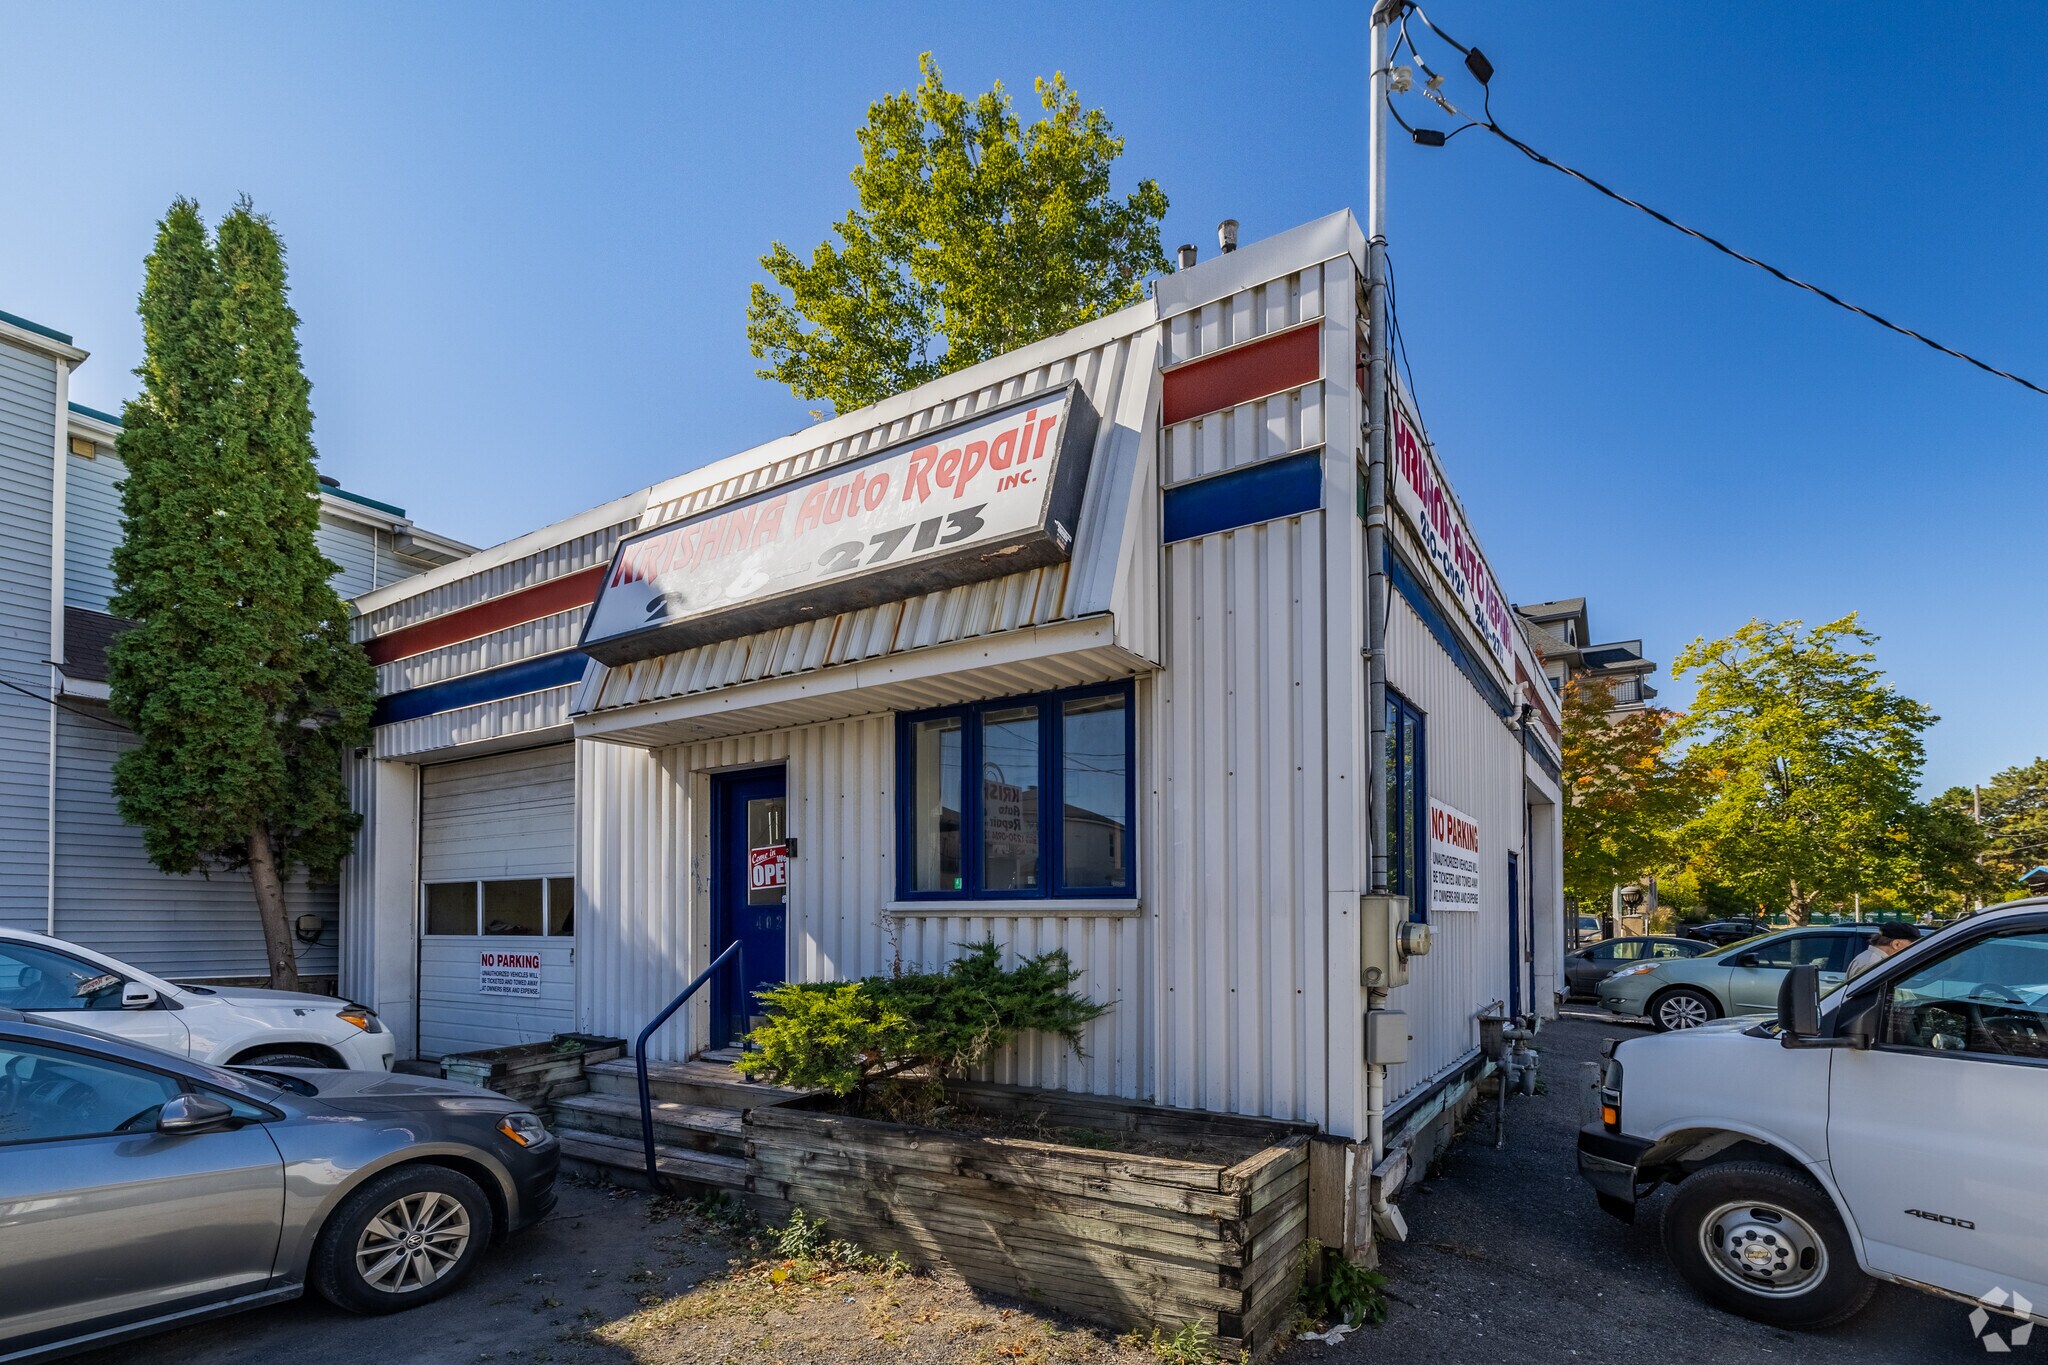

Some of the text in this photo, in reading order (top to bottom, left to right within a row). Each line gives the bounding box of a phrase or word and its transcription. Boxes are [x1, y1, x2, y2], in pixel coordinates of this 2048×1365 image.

[997, 469, 1037, 494] INC.
[611, 409, 1058, 588] KRISHNA Auto Repair
[1394, 407, 1513, 656] KRISHNA AUTO REPAIR
[1431, 806, 1478, 853] NO PARKING
[752, 849, 776, 864] Come in
[753, 863, 787, 886] OPE
[481, 953, 539, 969] NO PARKING
[1904, 1208, 1975, 1230] 4500
